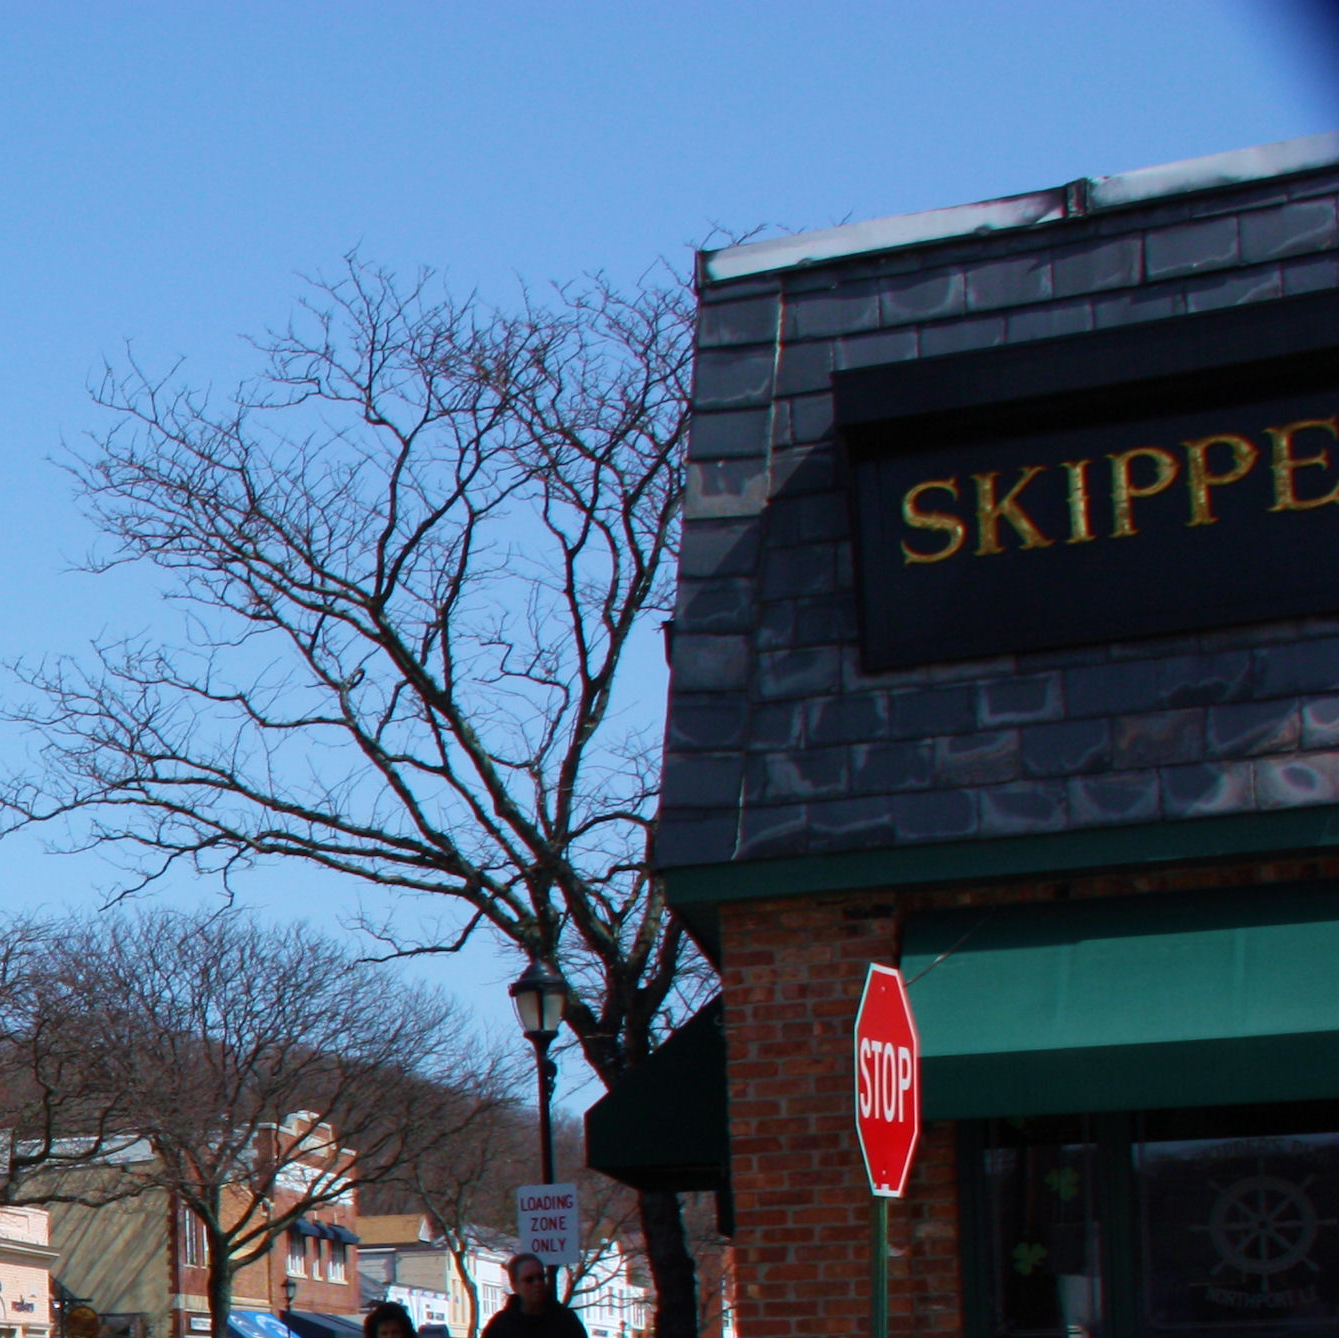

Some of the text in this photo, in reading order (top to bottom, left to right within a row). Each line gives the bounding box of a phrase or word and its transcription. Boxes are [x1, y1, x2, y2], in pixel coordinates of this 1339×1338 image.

[860, 1037, 912, 1123] STOP
[520, 1194, 573, 1211] LOADING
[531, 1216, 567, 1232] ZONE
[531, 1238, 566, 1253] ONLY
